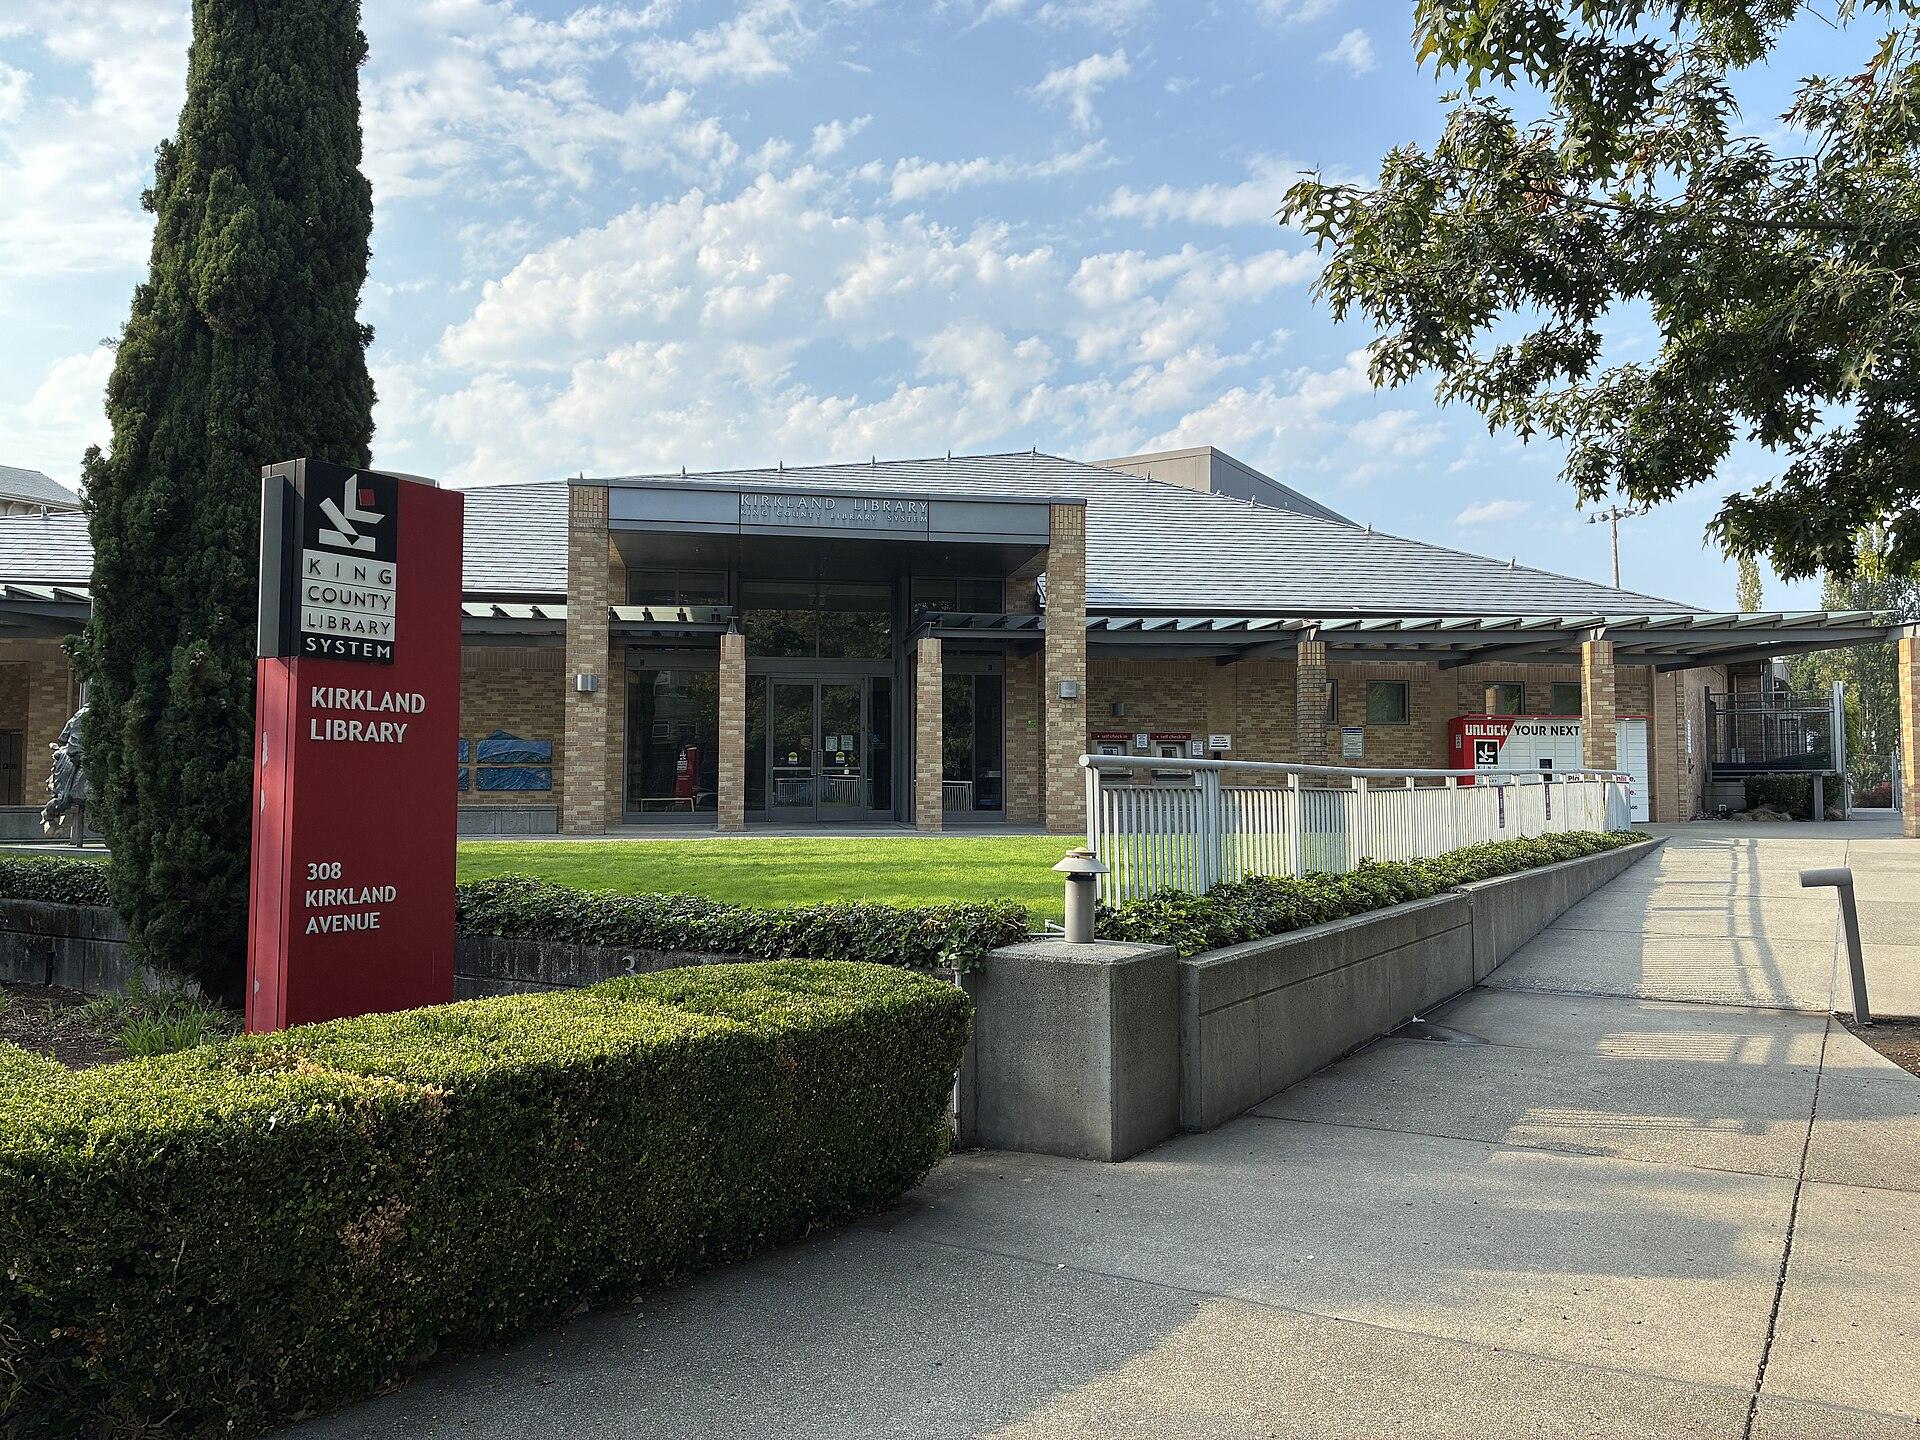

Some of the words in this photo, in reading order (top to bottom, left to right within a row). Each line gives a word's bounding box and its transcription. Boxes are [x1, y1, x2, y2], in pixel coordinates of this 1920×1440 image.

[740, 508, 768, 517] KING
[776, 510, 821, 519] COUNTY
[831, 513, 877, 521] LIBRARY
[887, 514, 928, 522] SYSTEM
[741, 495, 835, 510] KIRKLAND
[854, 499, 928, 513] LIBRARY
[308, 557, 392, 585] KING
[308, 586, 391, 610] COUNTY
[307, 613, 391, 635] LIBRARY
[306, 637, 391, 659] SYSTEM
[311, 686, 426, 714] KIRKLAND
[310, 719, 408, 743] LIBRARY
[1465, 724, 1508, 736] UNLOCK
[1514, 725, 1546, 736] YOUR
[1551, 725, 1580, 736] NEXT
[306, 862, 342, 881] 308
[305, 885, 397, 908] KIRKLAND
[305, 912, 381, 935] AVENUE
